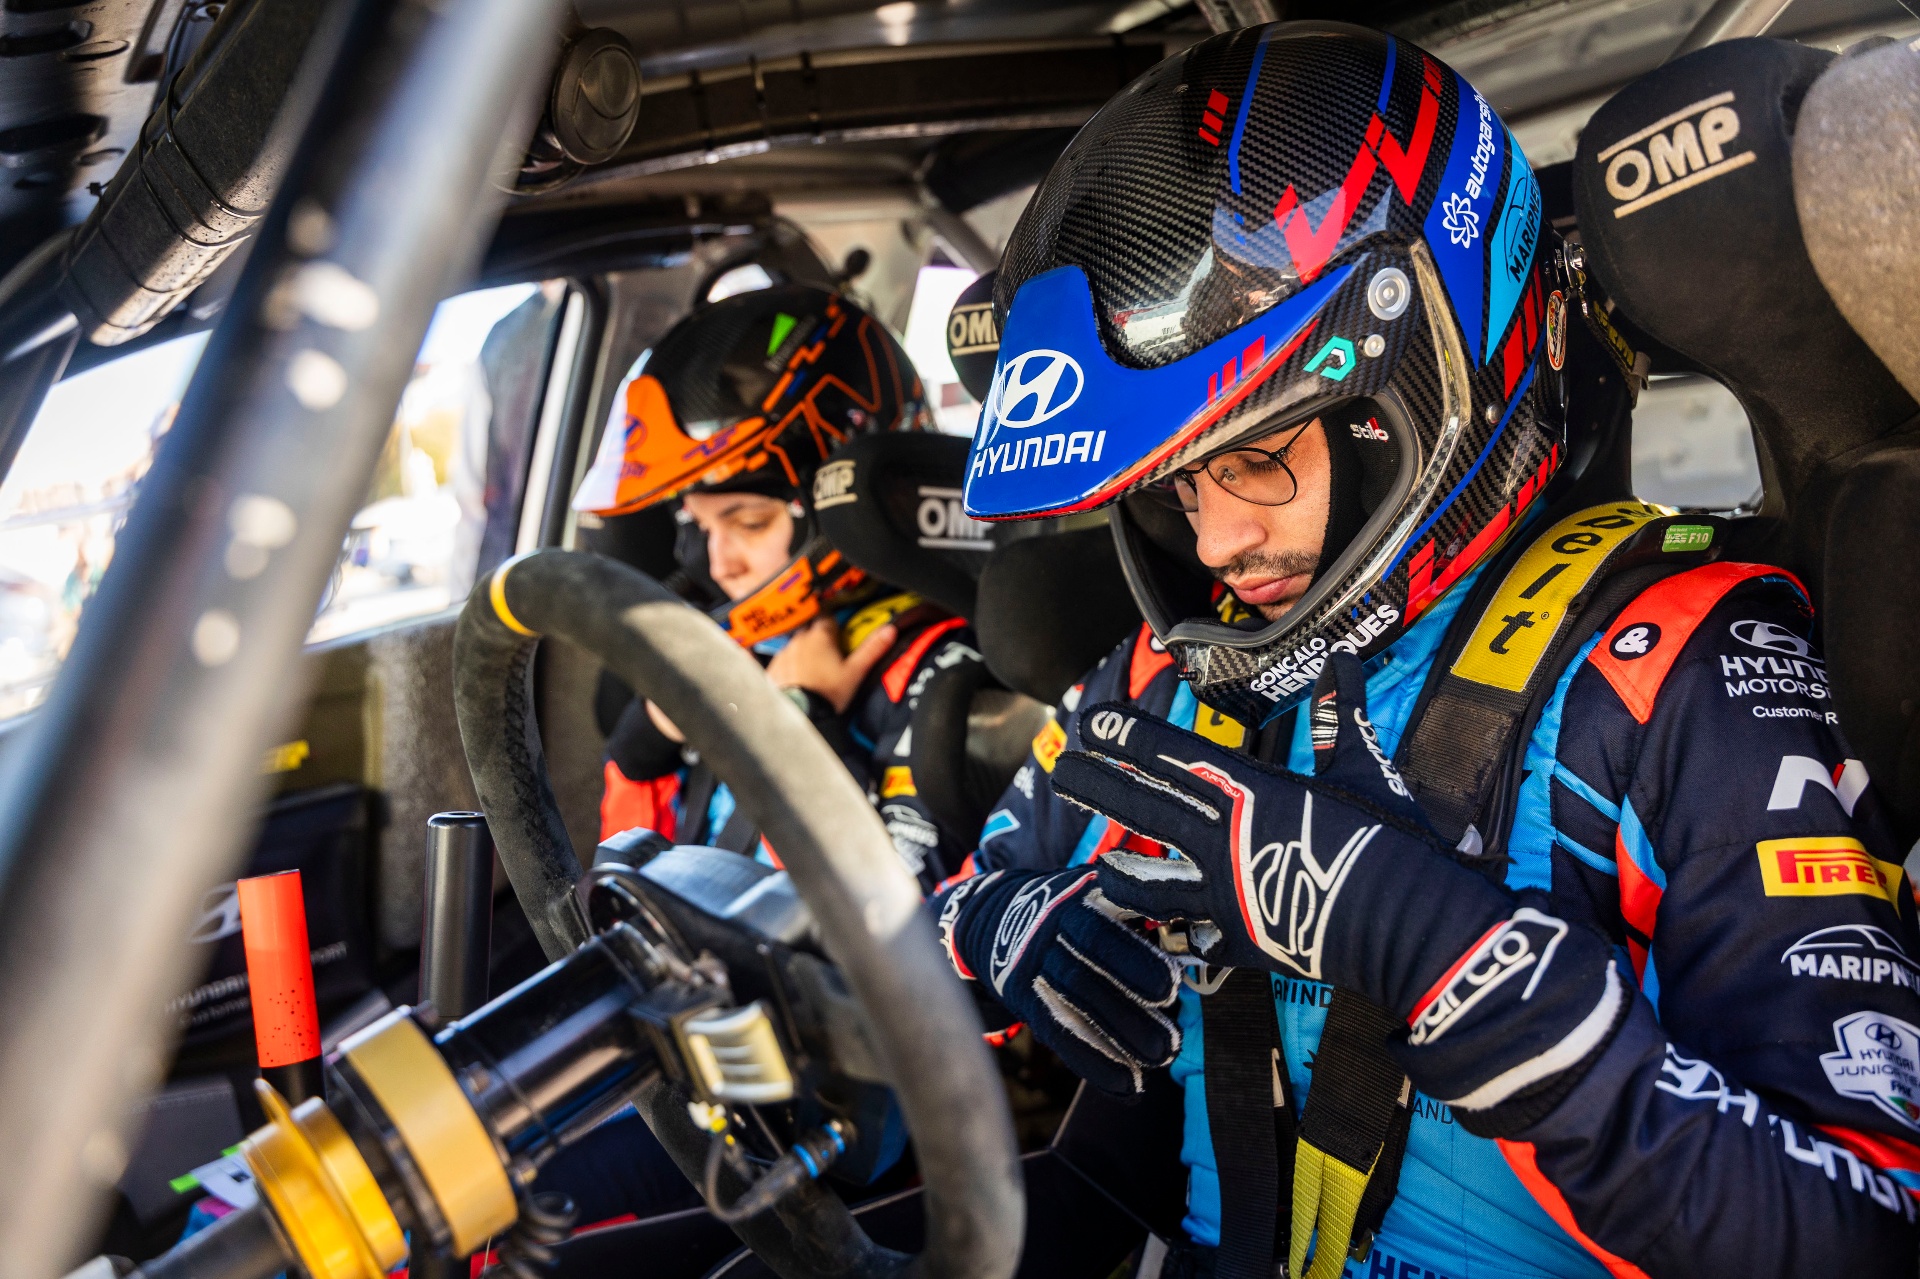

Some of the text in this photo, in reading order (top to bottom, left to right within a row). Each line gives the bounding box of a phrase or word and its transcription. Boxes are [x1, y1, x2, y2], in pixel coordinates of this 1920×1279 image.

[1605, 106, 1740, 201] OMP
[950, 310, 999, 348] OM
[974, 430, 1107, 478] HYUNDAI
[1688, 532, 1709, 543] F10
[1250, 637, 1326, 692] GONÇALO
[1260, 604, 1400, 703] HENQUES
[1201, 770, 1241, 798] ARROW
